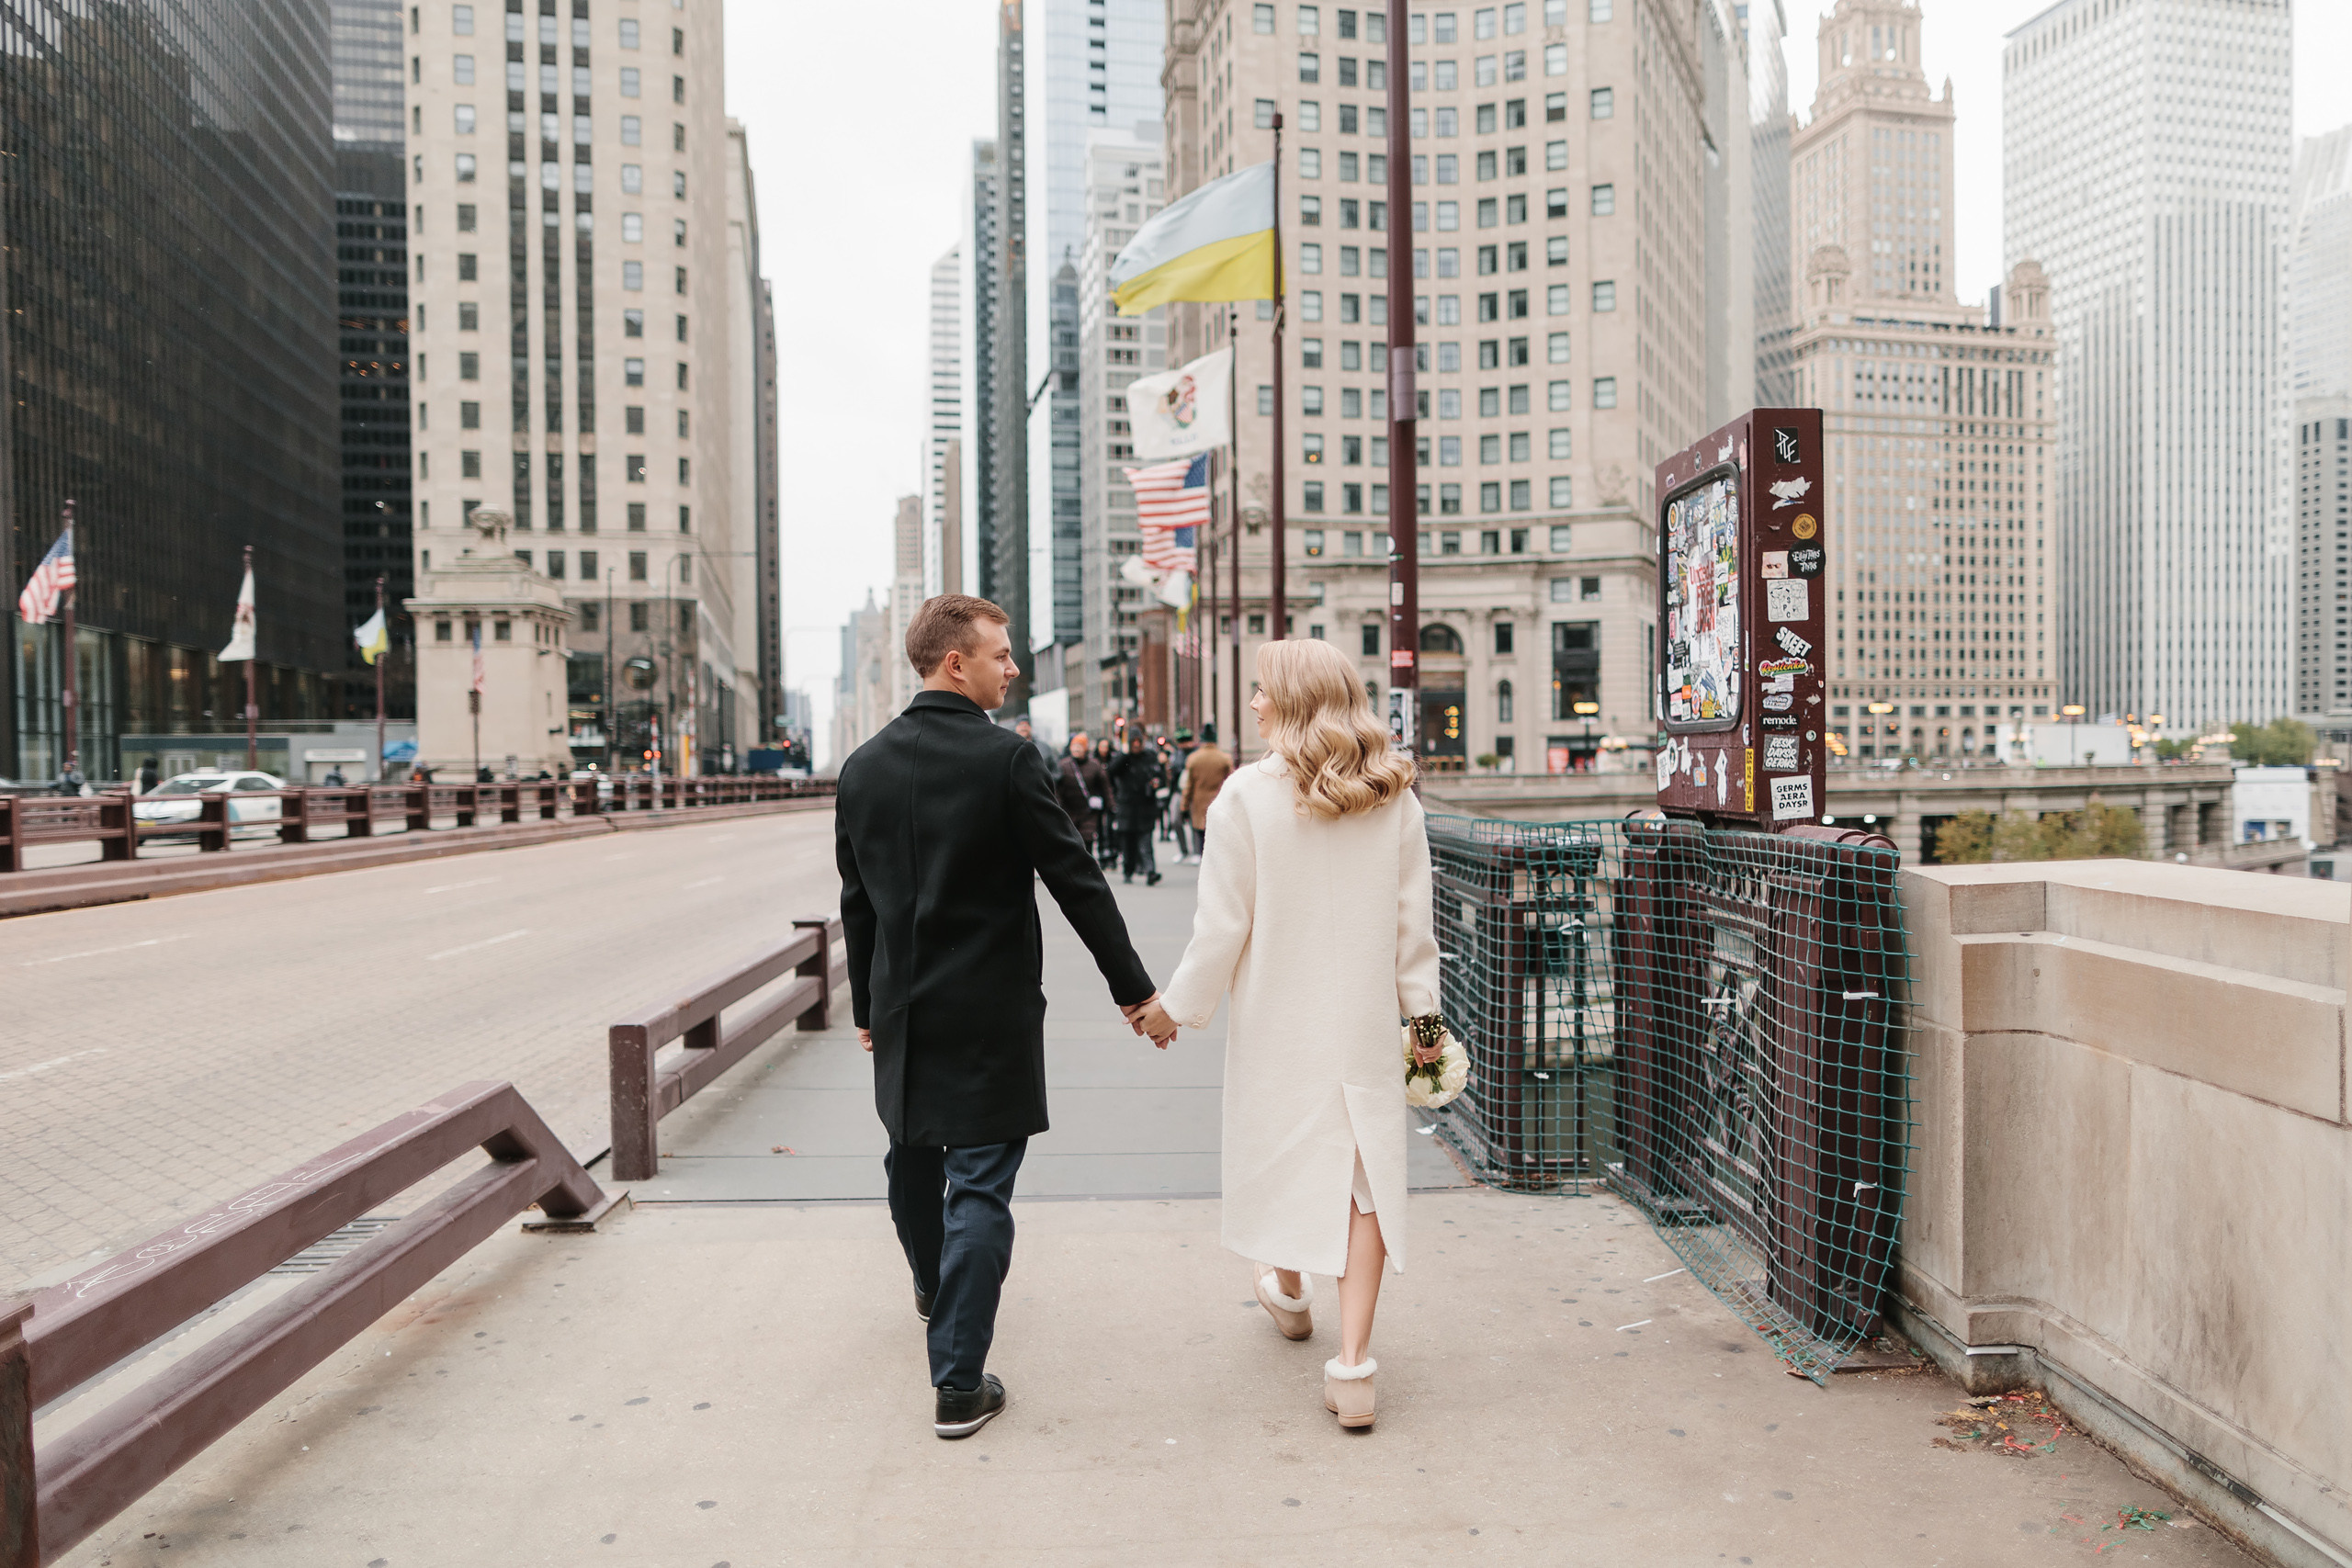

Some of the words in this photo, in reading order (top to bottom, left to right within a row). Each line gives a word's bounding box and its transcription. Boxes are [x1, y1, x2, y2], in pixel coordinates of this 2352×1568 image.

[1775, 626, 1813, 657] SKEET
[1776, 783, 1808, 793] GERMS
[1780, 792, 1806, 802] AERA
[1779, 800, 1808, 809] DAYSR
